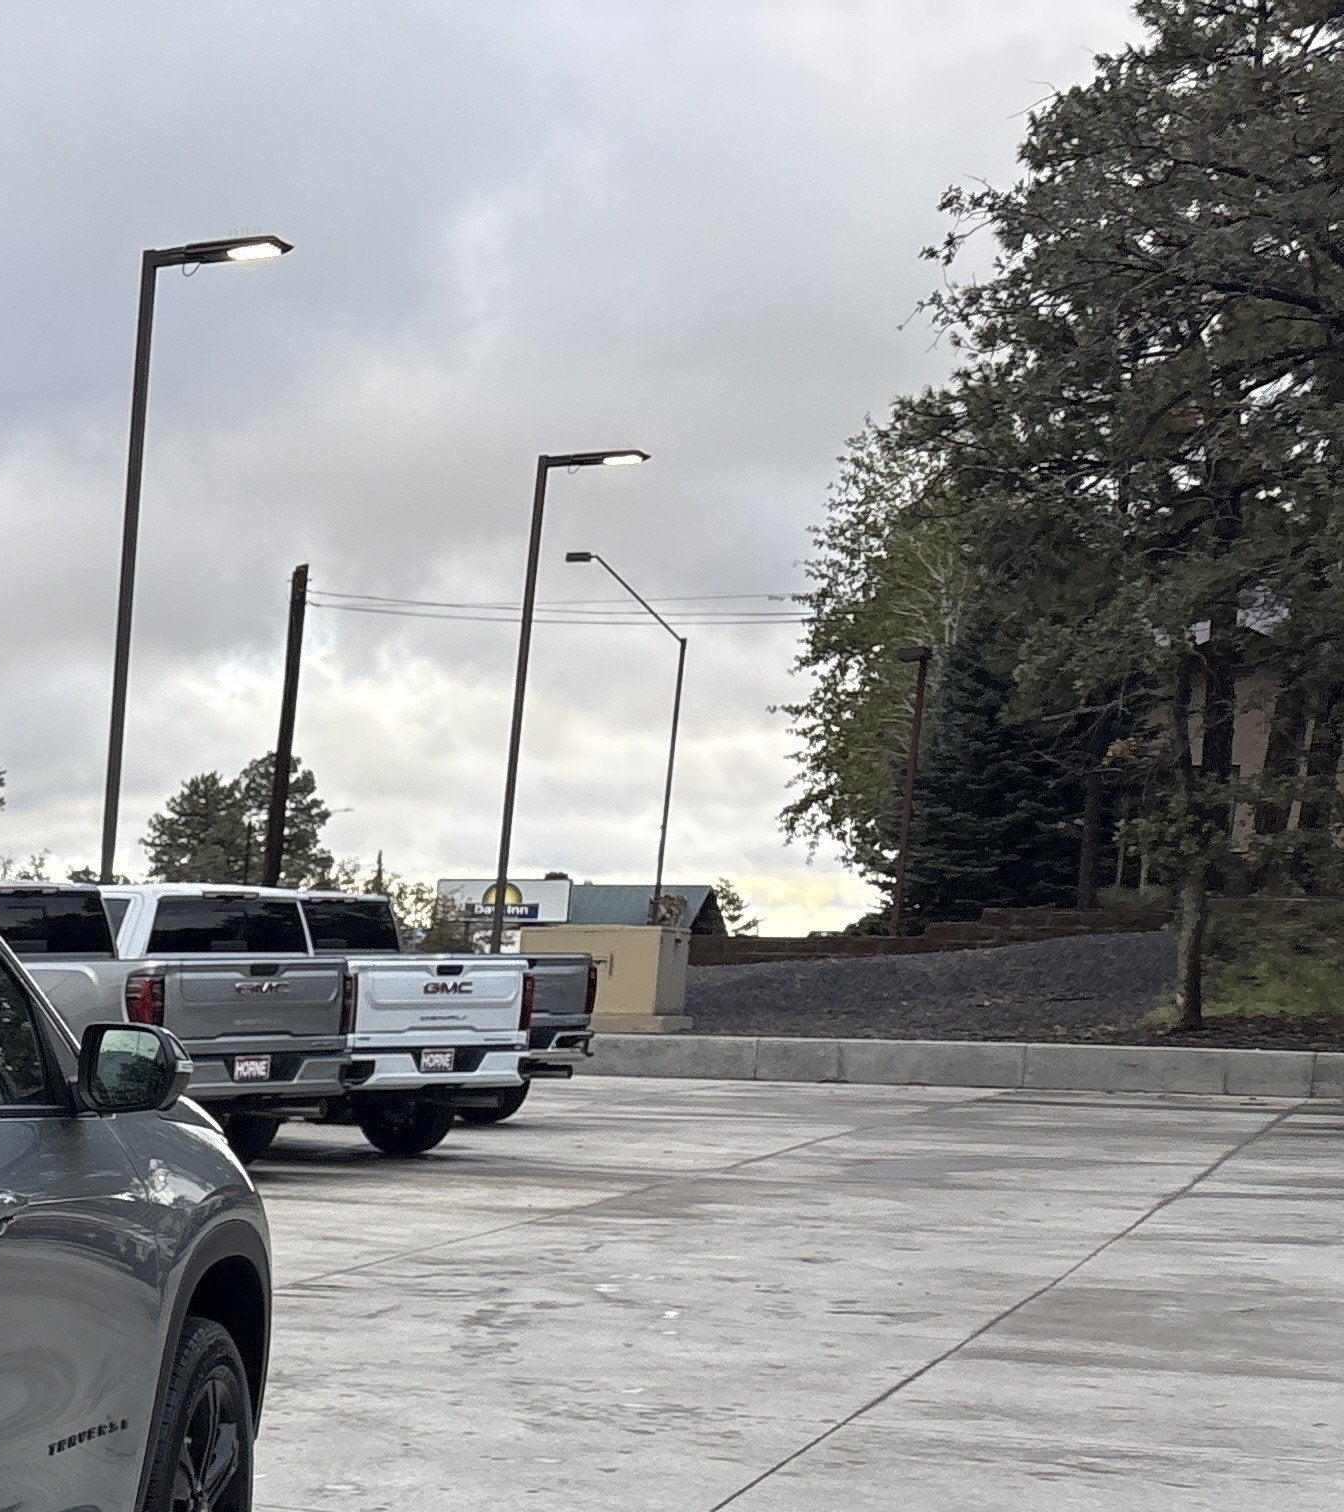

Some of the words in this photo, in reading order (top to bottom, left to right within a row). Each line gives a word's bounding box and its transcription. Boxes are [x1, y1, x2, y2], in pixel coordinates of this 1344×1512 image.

[507, 903, 529, 915] Inn
[423, 981, 473, 994] GMC
[235, 1060, 268, 1078] HORNE
